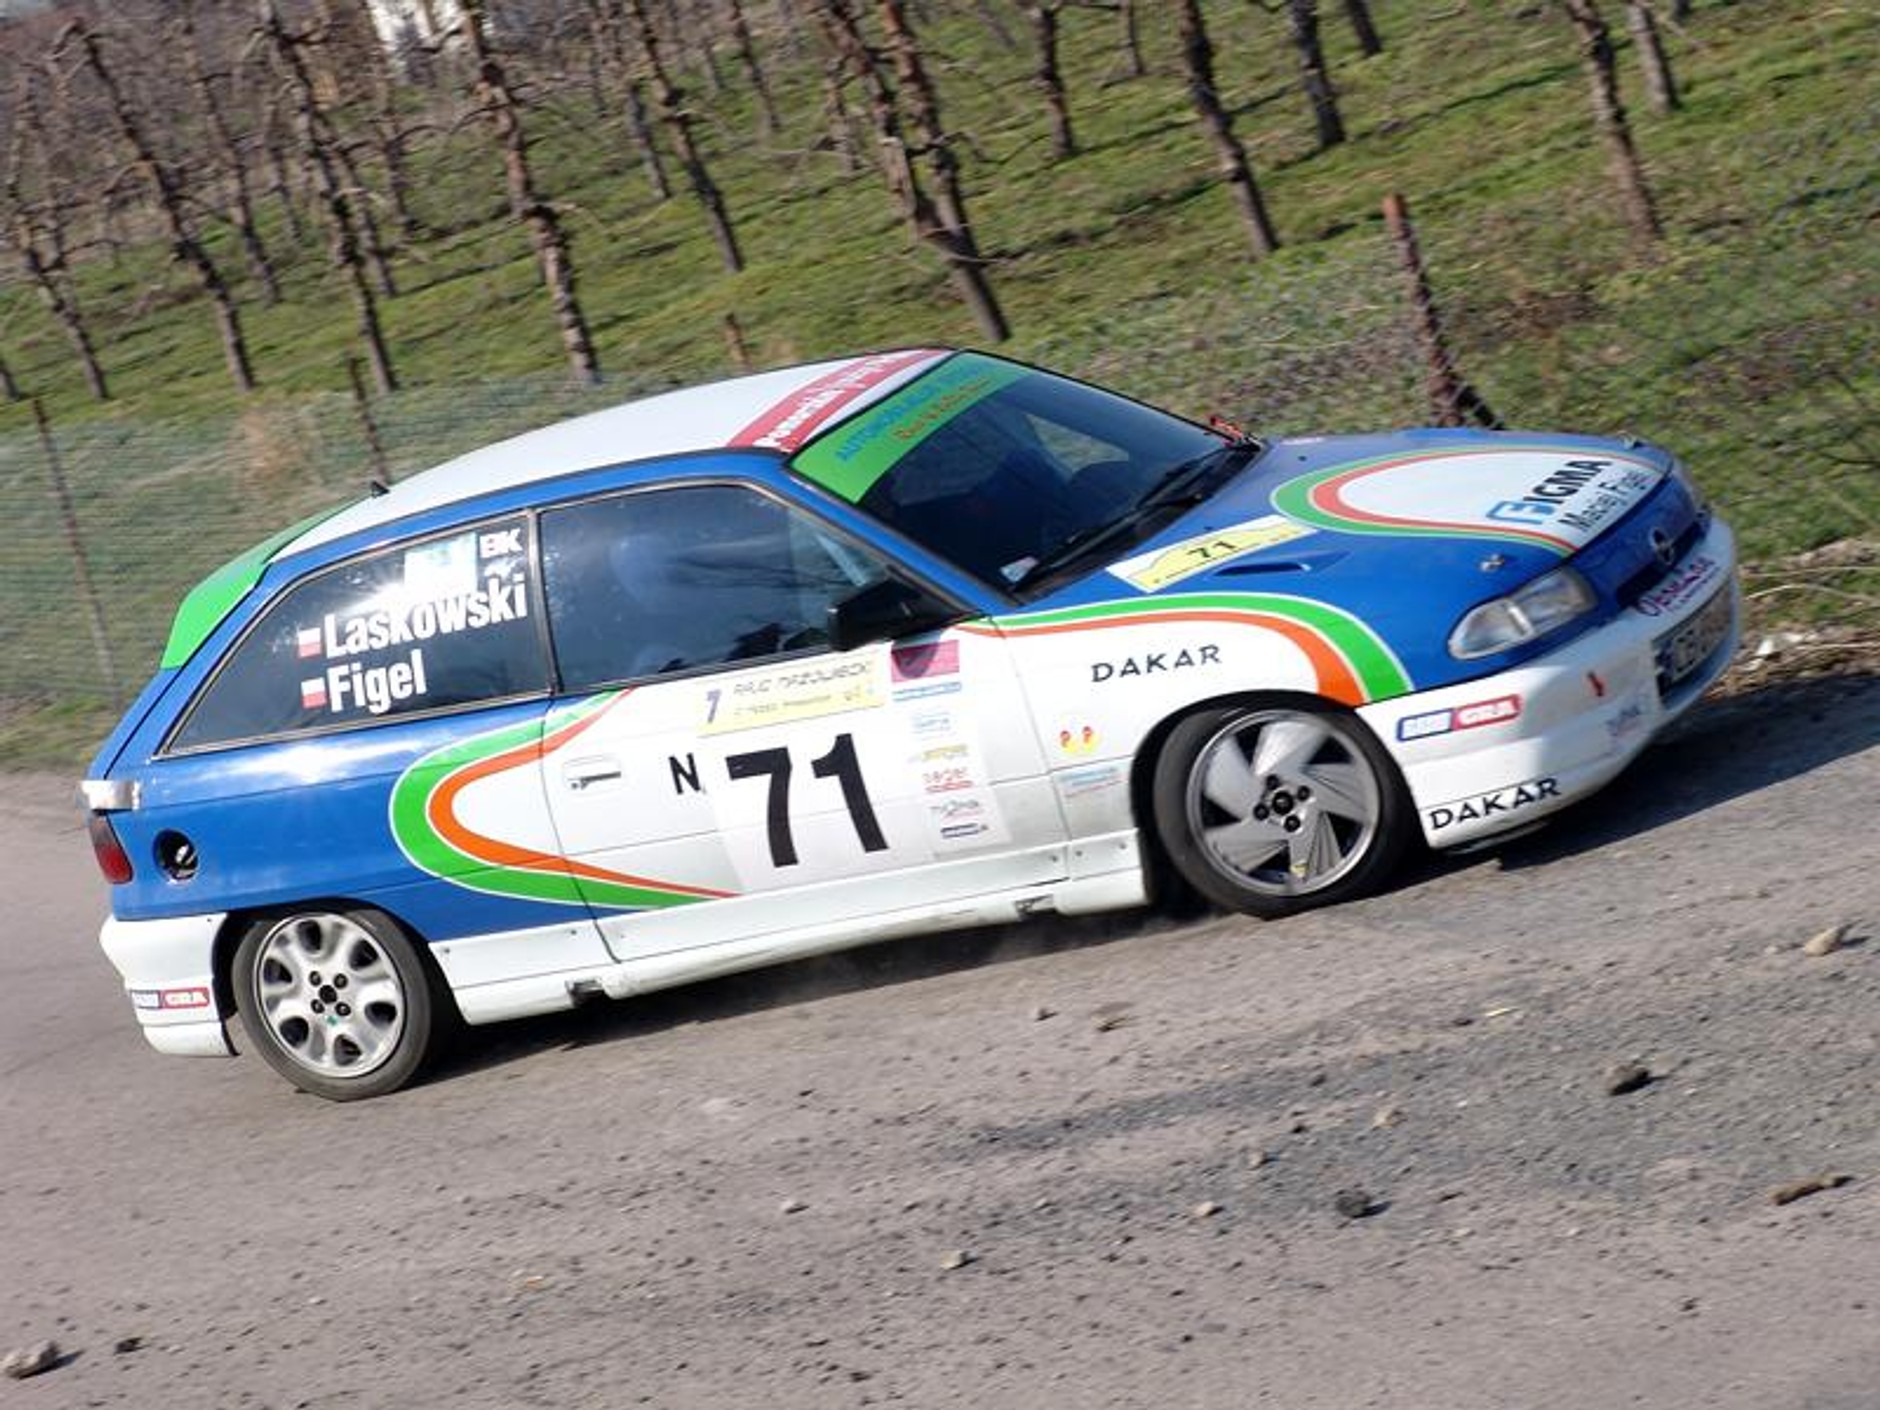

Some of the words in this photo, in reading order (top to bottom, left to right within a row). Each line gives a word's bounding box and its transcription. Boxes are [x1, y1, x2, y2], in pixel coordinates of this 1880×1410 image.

[1186, 540, 1237, 559] 71
[324, 573, 528, 659] Laskowski
[326, 649, 428, 715] Figel
[1091, 643, 1221, 683] DAKAR
[669, 752, 702, 795] N
[725, 732, 889, 868] 71
[1429, 777, 1562, 830] DAKAR
